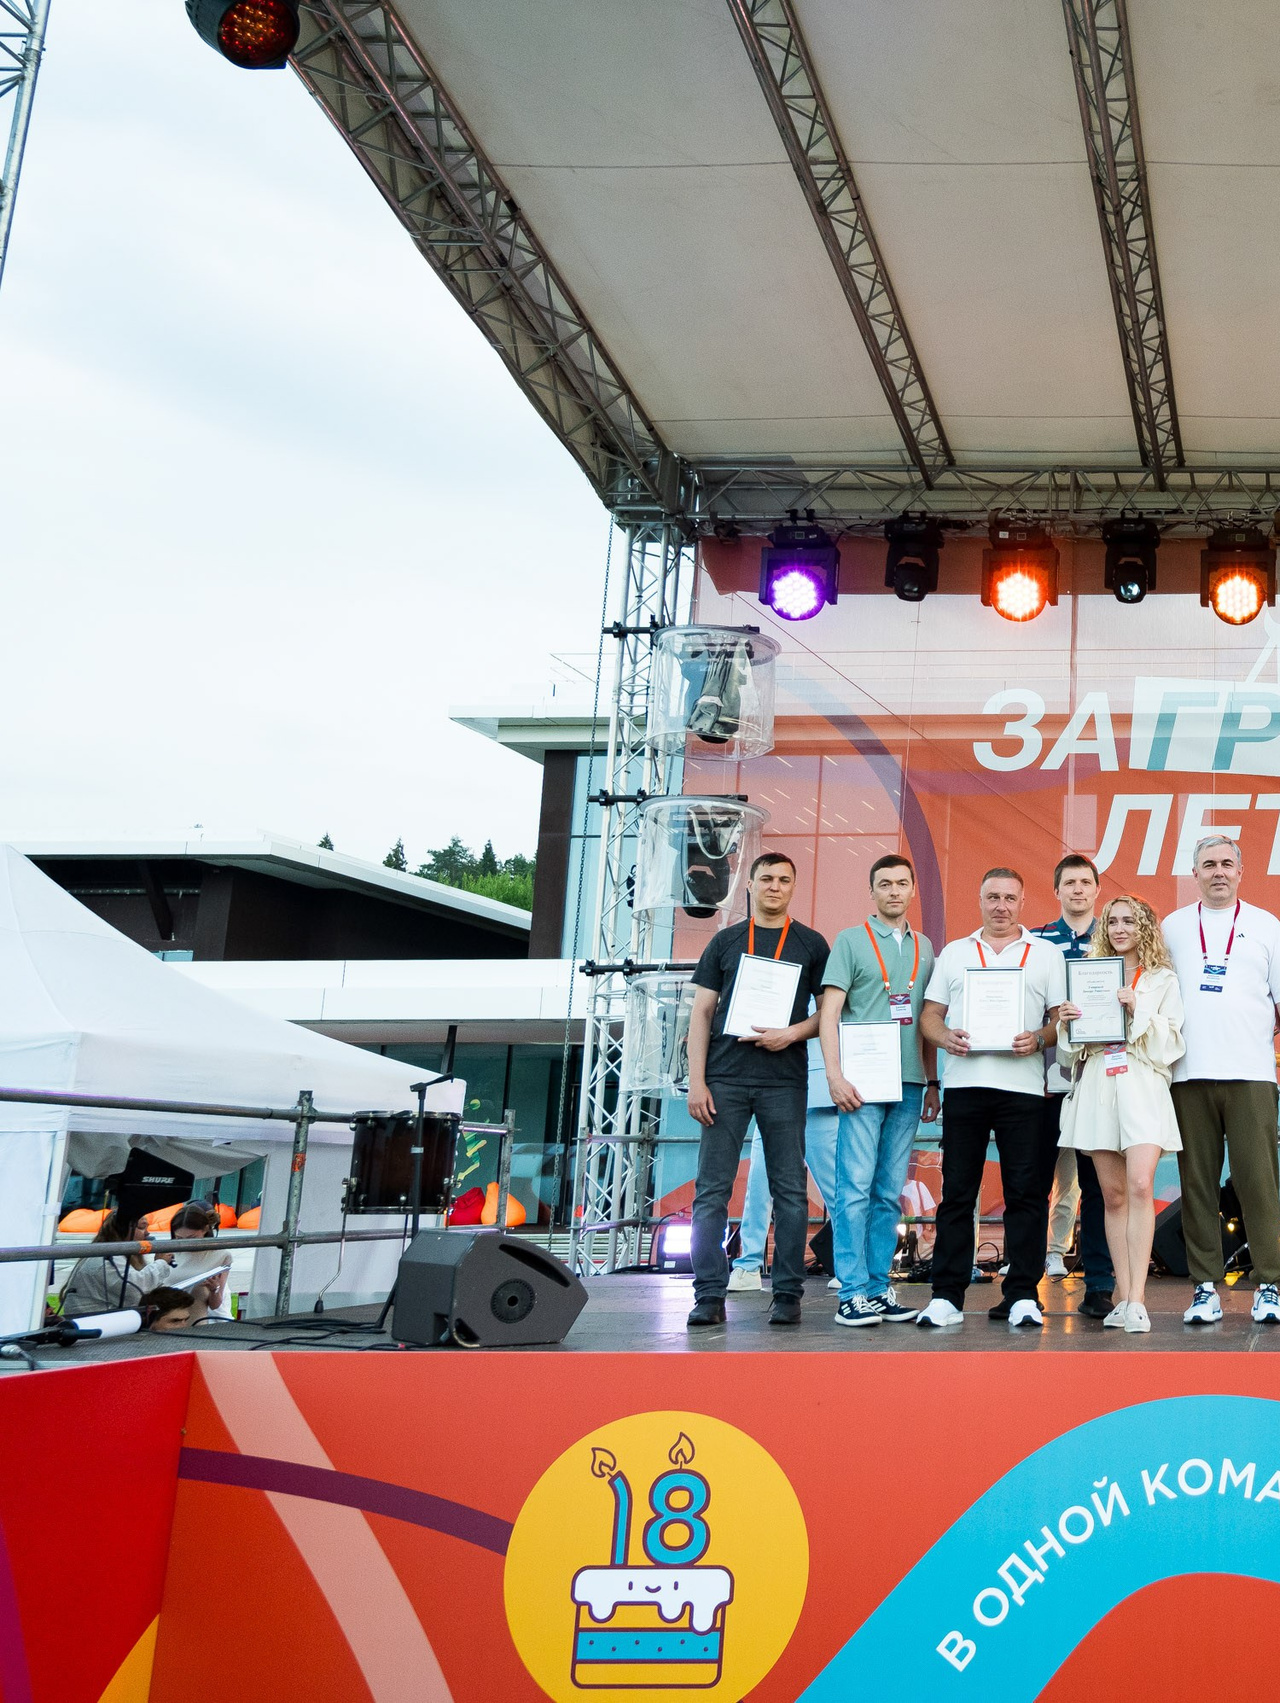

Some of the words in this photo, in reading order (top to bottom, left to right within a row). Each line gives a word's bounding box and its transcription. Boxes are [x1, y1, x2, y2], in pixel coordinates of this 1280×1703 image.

[141, 1176, 175, 1184] SHURE
[608, 1469, 711, 1567] 18
[936, 1630, 977, 1672] В
[973, 1476, 1131, 1627] ОДНОЙ
